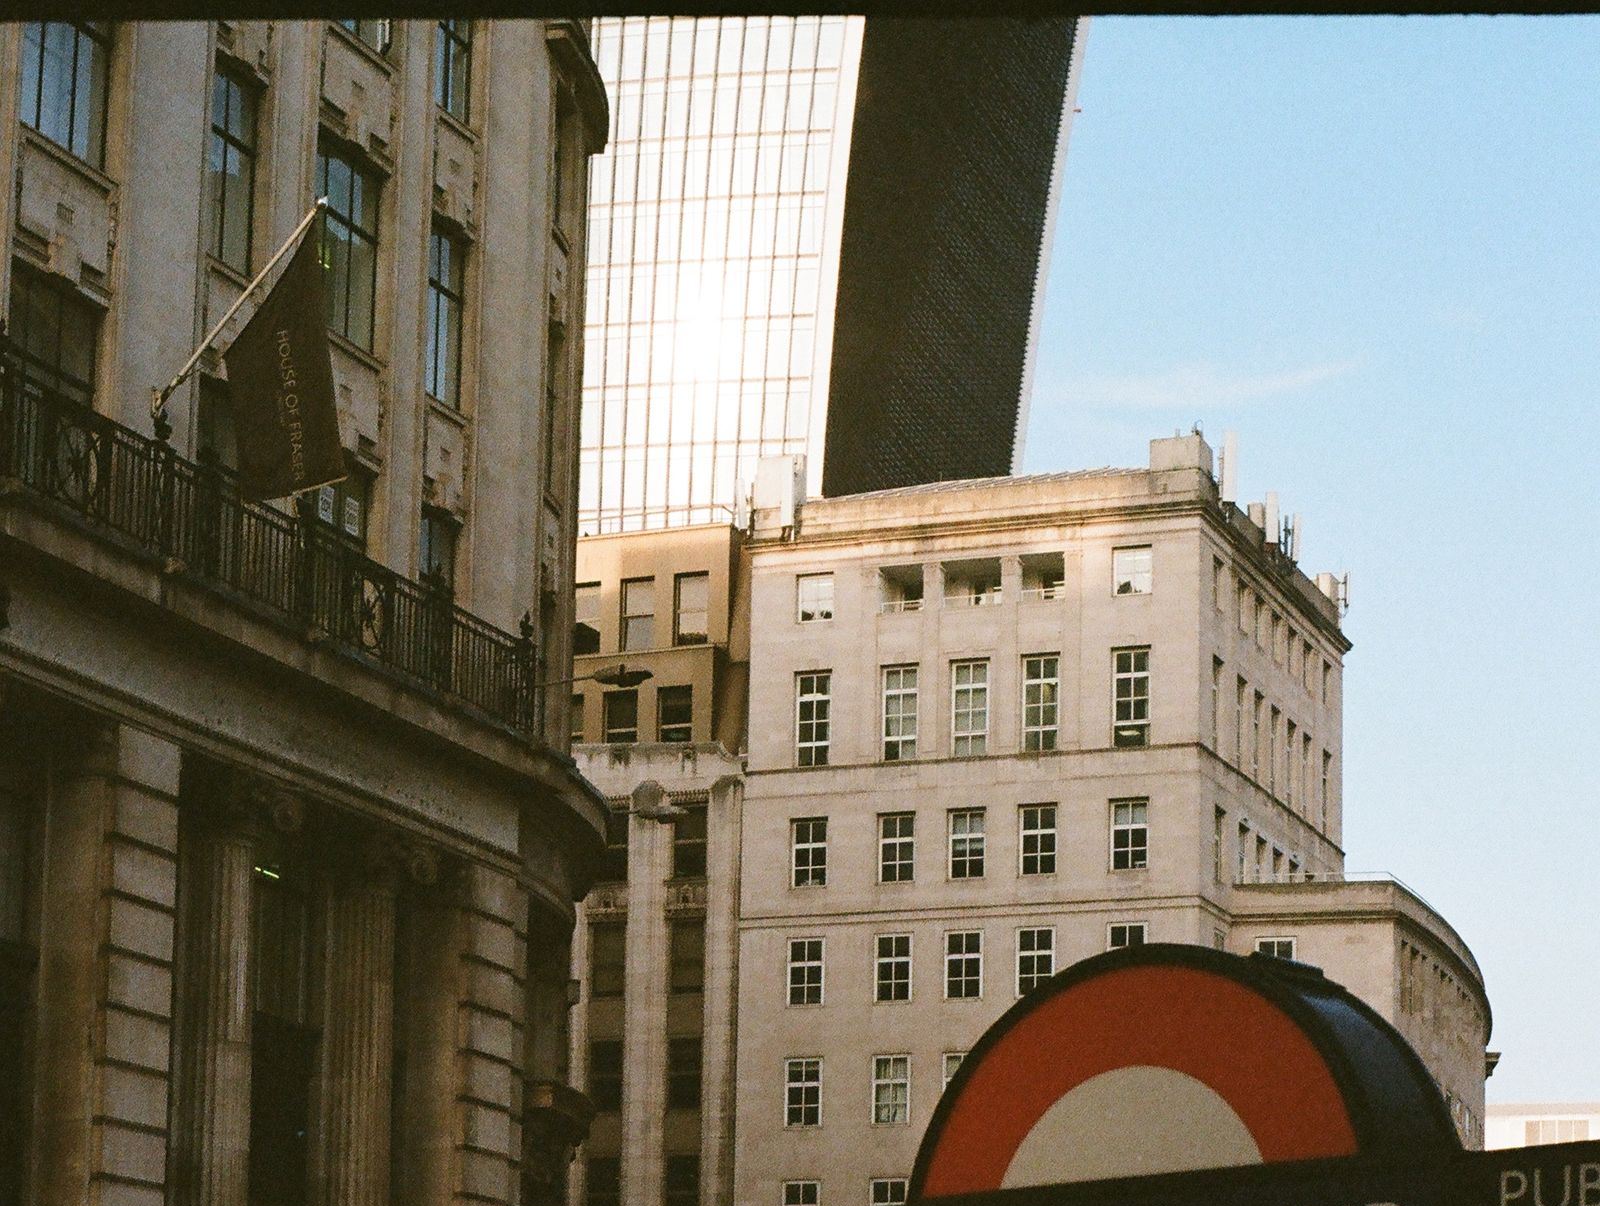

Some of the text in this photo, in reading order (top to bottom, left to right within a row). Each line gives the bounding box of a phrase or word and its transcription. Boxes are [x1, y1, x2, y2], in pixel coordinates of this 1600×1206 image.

[277, 330, 296, 389] HOUSE
[285, 394, 299, 416] OF
[289, 421, 305, 481] FRASER
